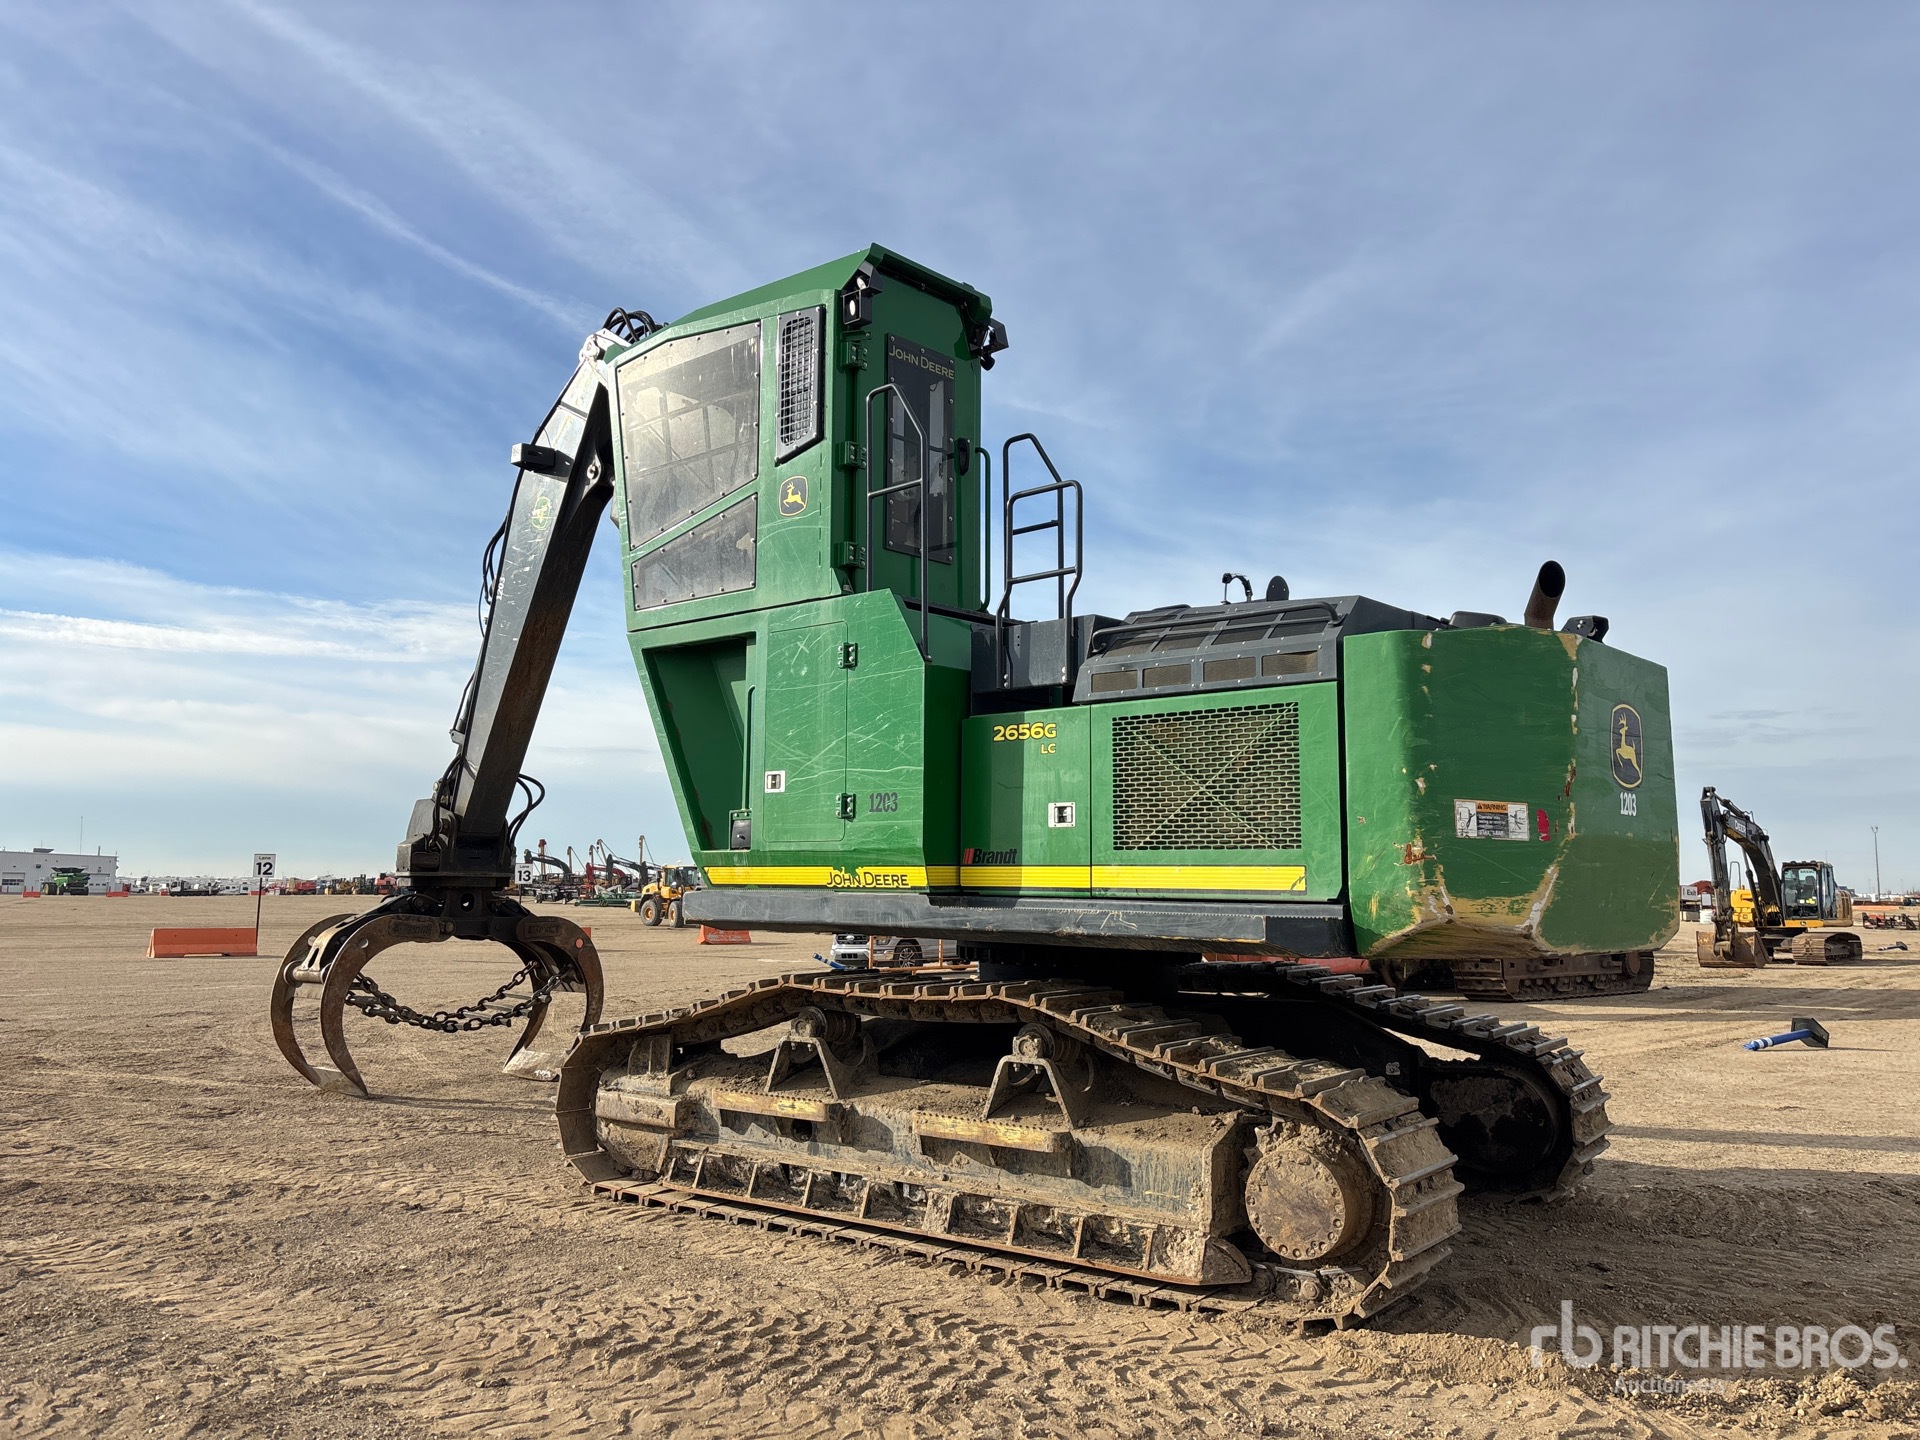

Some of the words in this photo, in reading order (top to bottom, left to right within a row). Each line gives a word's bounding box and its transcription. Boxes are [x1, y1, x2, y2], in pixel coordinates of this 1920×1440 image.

[889, 345, 919, 366] JOHN
[920, 356, 955, 380] DEERE
[993, 721, 1057, 742] 2656G
[1040, 743, 1056, 754] LC
[869, 791, 898, 812] 1203
[1482, 803, 1507, 811] WARNING
[1620, 791, 1637, 817] 1203
[973, 848, 1018, 864] Brandt
[256, 861, 273, 875] 12
[517, 870, 531, 882] 13
[827, 872, 861, 886] JOHN
[863, 872, 909, 886] DEERE
